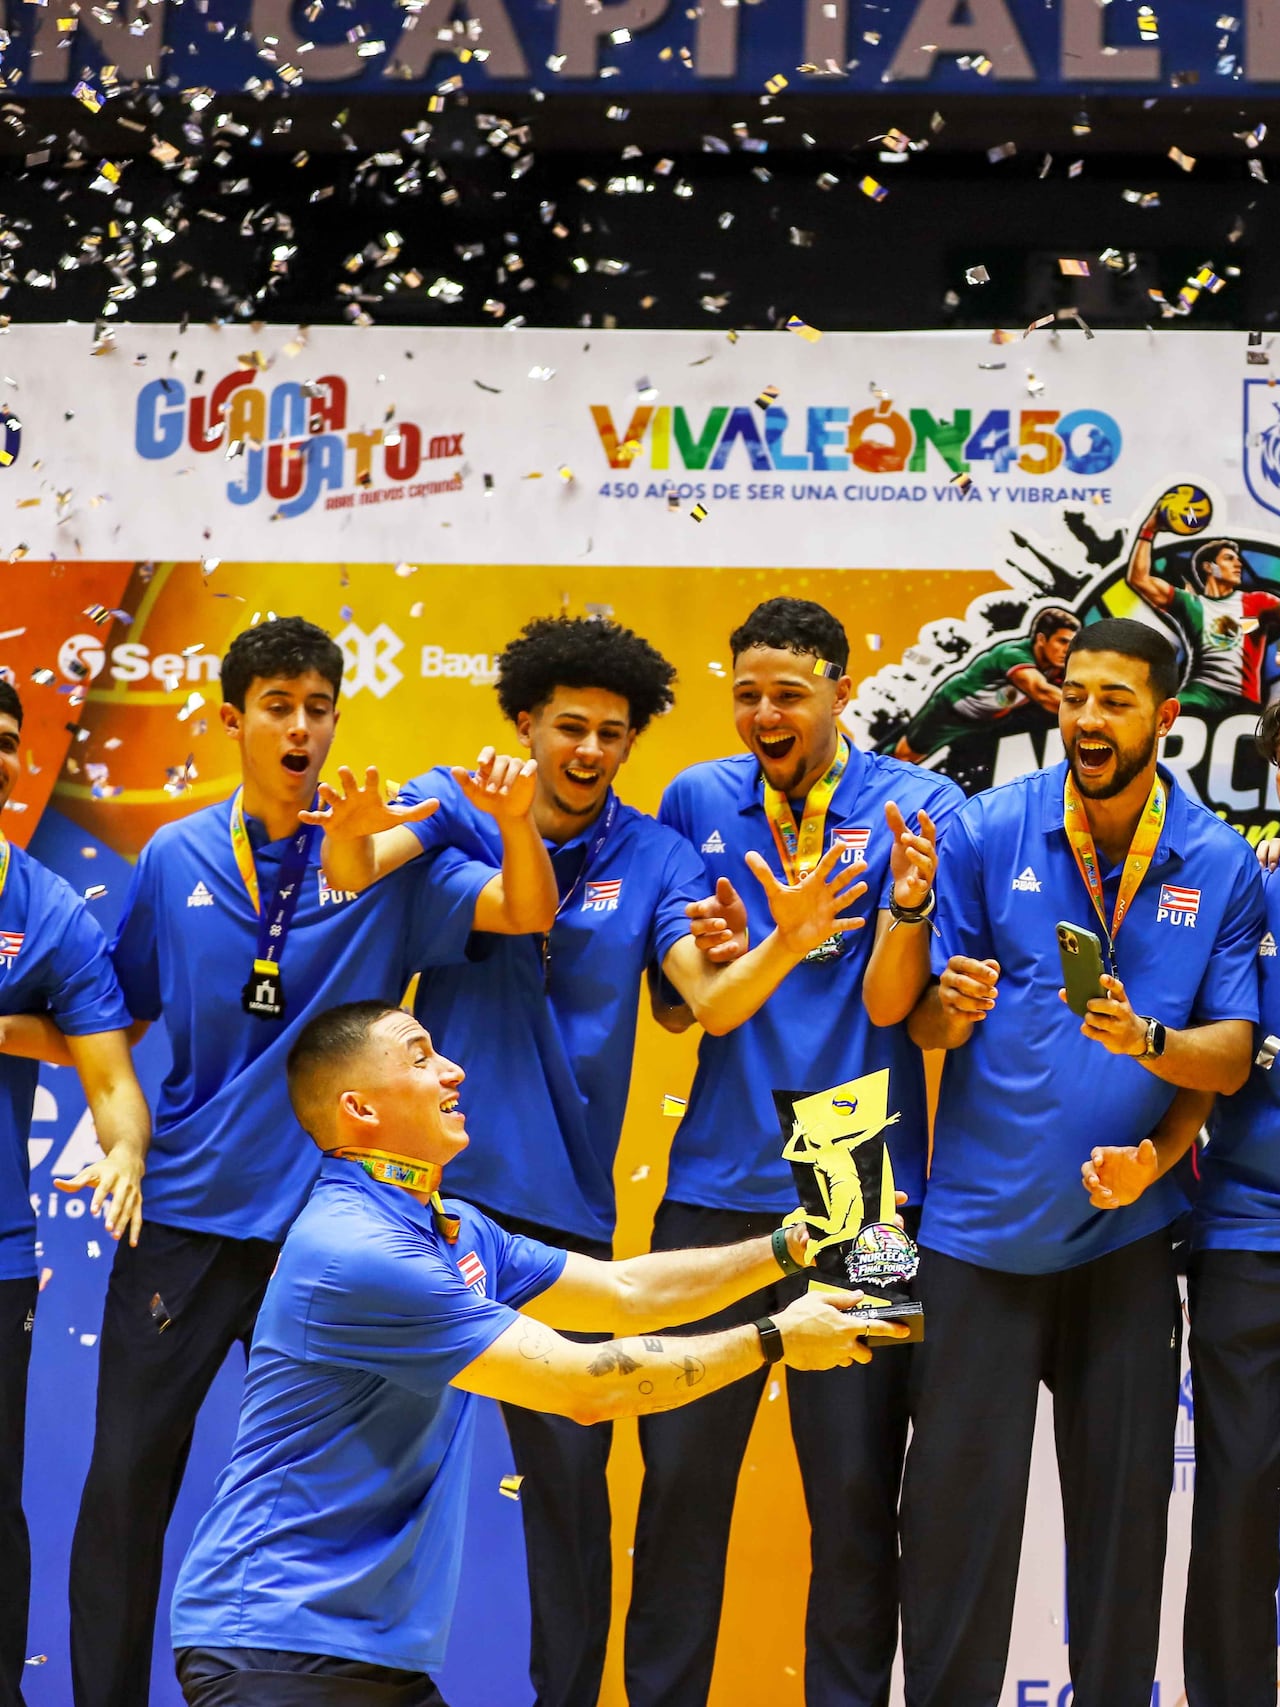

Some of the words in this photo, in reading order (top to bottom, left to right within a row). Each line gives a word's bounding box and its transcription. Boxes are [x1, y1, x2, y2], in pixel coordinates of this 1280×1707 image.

[250, 0, 1163, 85] CAPITAL
[598, 482, 639, 499] 450
[645, 479, 706, 499] AÑOS
[713, 484, 741, 499] DE
[747, 484, 785, 500] SER
[791, 485, 838, 501] UNA
[843, 485, 927, 502] CIUDAD
[933, 485, 982, 502] VIVA
[988, 486, 1001, 502] Y
[1006, 486, 1112, 504] VIBRANTE
[110, 643, 222, 682] Sen
[421, 645, 501, 678] Baxu
[841, 849, 865, 864] UR
[581, 898, 618, 912] PUR
[1157, 908, 1197, 928] PUR
[859, 1251, 906, 1265] NORCECA
